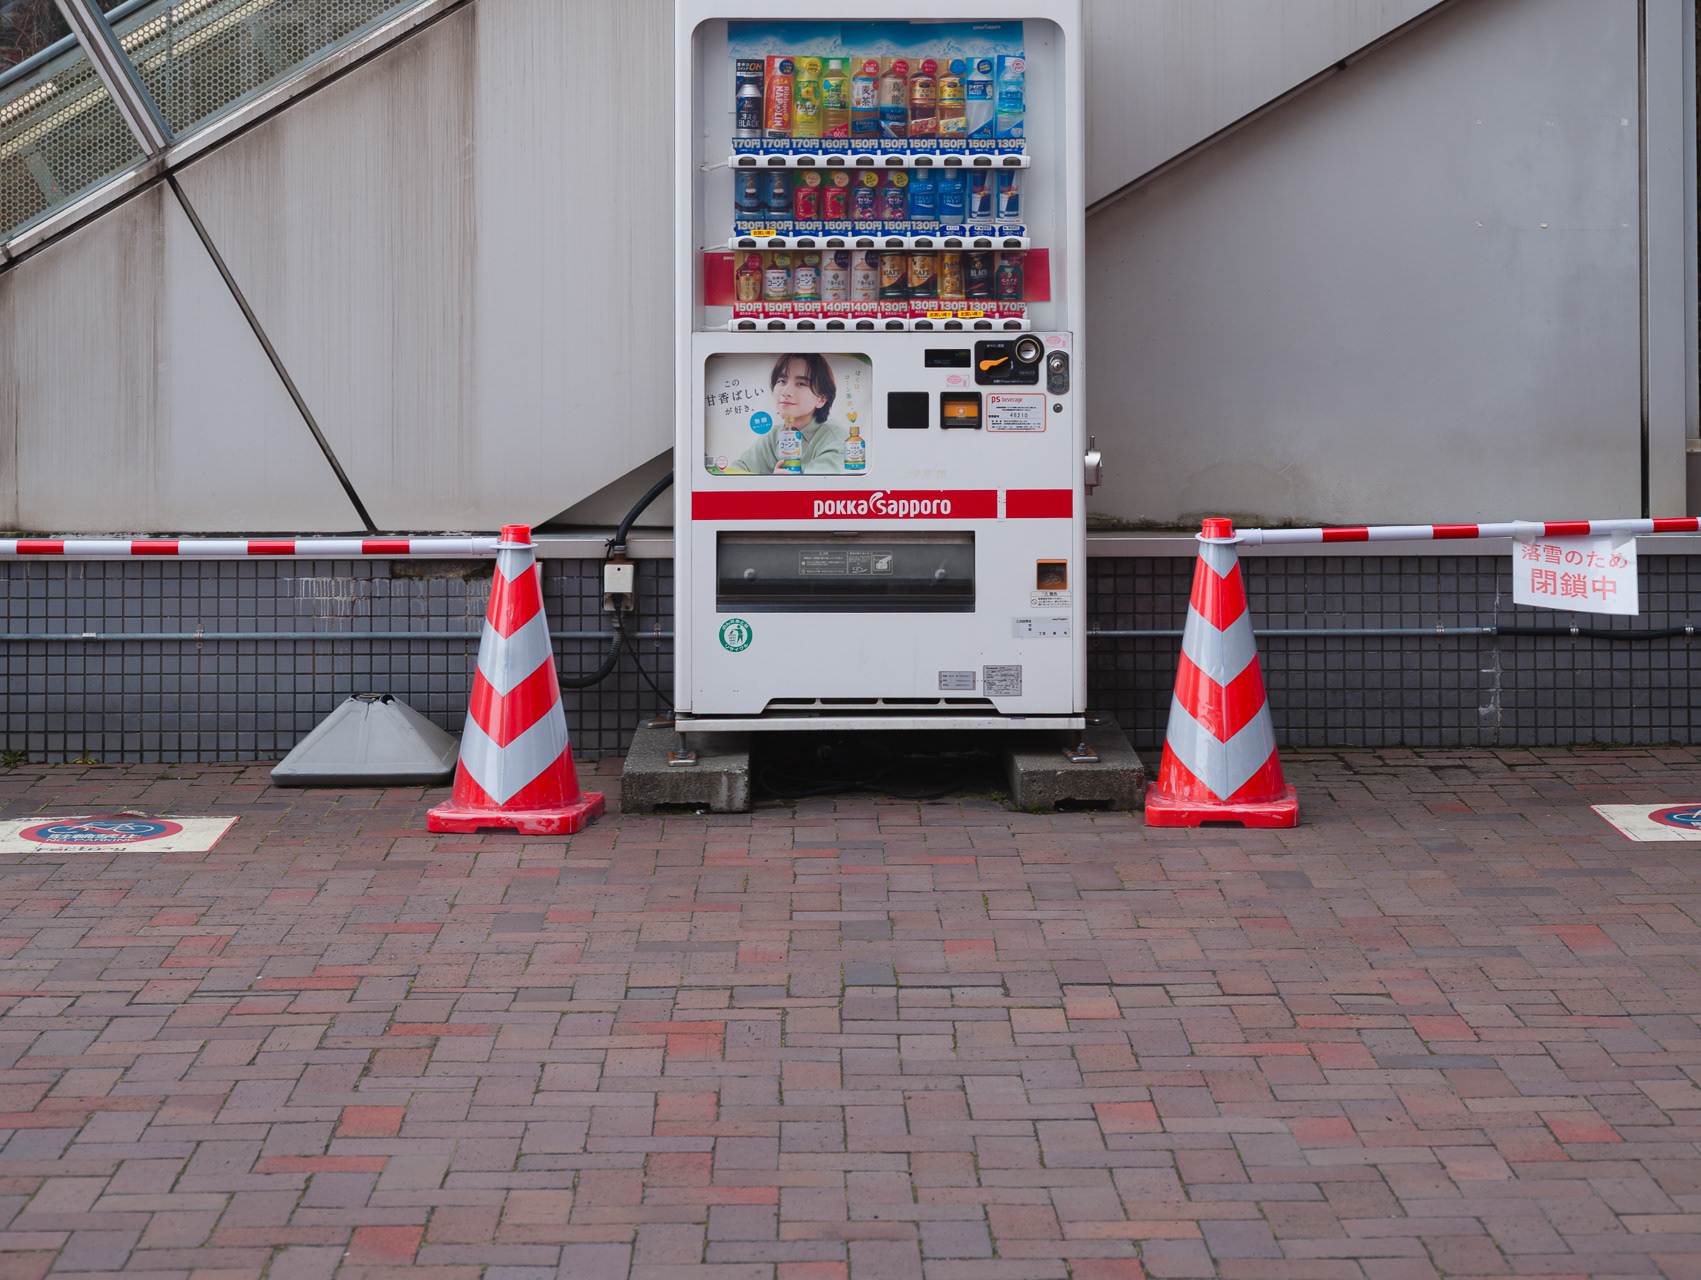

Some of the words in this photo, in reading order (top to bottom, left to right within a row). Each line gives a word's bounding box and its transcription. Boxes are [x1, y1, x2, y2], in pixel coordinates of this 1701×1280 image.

[861, 85, 871, 107] 麦茶
[774, 86, 784, 126] NAPOLIN
[738, 119, 760, 128] BLACK
[733, 139, 760, 149] 170円
[762, 139, 790, 149] 170円
[791, 139, 819, 149] 170円
[821, 139, 849, 149] 160円
[850, 139, 878, 149] 150円
[880, 139, 908, 149] 150円
[909, 139, 937, 149] 150円
[938, 139, 966, 149] 150円
[968, 139, 996, 149] 150円
[997, 139, 1025, 149] 130円
[736, 221, 764, 231] 130円
[765, 221, 793, 231] 130円
[794, 221, 822, 231] 150円
[824, 221, 852, 231] 150円
[854, 221, 882, 231] 150円
[883, 221, 911, 231] 150円
[911, 221, 939, 231] 130円
[735, 302, 762, 312] 150円
[764, 302, 792, 312] 150円
[793, 302, 821, 312] 150円
[822, 302, 850, 312] 140円
[850, 302, 878, 312] 140円
[880, 302, 908, 312] 130円
[910, 301, 938, 311] 130円
[940, 301, 967, 311] 130円
[969, 301, 997, 311] 130円
[998, 301, 1026, 311] 170円
[724, 378, 740, 388] この
[705, 387, 765, 407] 甘香ばしい
[780, 441, 800, 449] コーン茶
[813, 499, 868, 518] pokka
[873, 496, 951, 518] sapporo
[1521, 541, 1628, 570] 落雪のため
[1530, 567, 1618, 601] 閉鎖中
